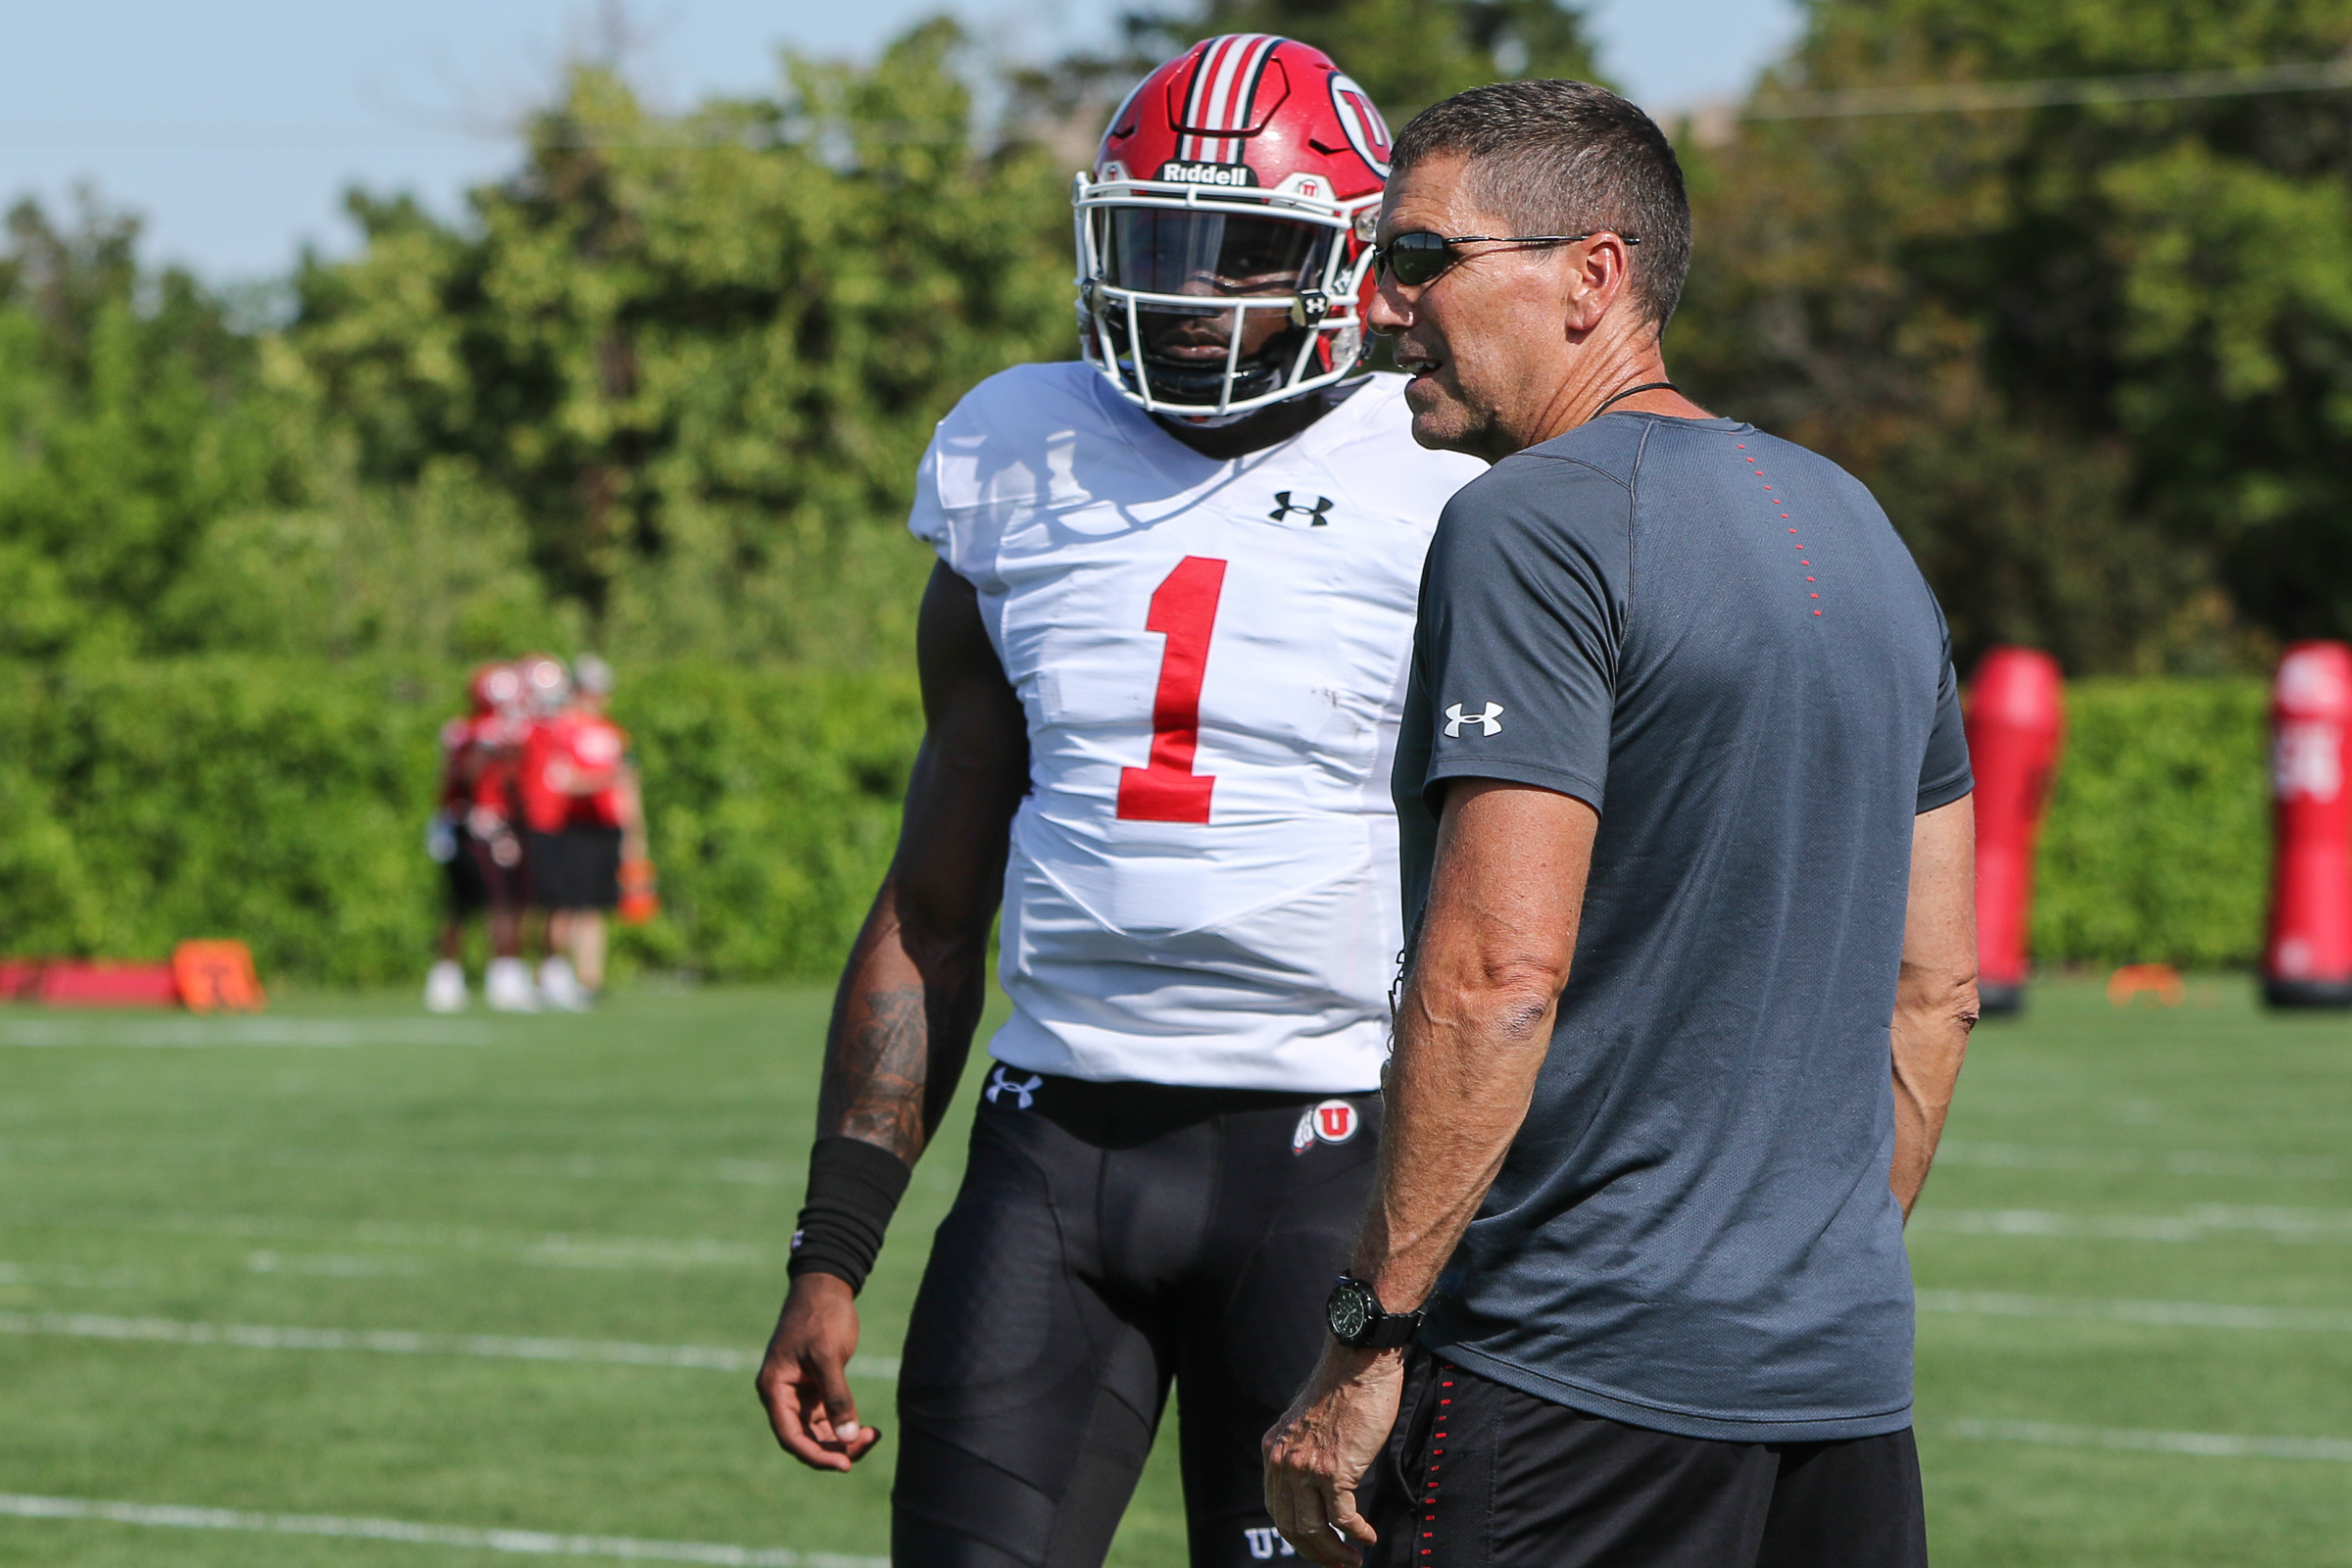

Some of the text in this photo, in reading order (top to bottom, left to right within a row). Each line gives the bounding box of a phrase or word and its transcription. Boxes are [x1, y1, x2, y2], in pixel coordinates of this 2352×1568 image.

[1337, 89, 1391, 165] U
[1163, 163, 1248, 186] Riddell
[1116, 556, 1228, 824] 1
[1319, 1107, 1349, 1136] U
